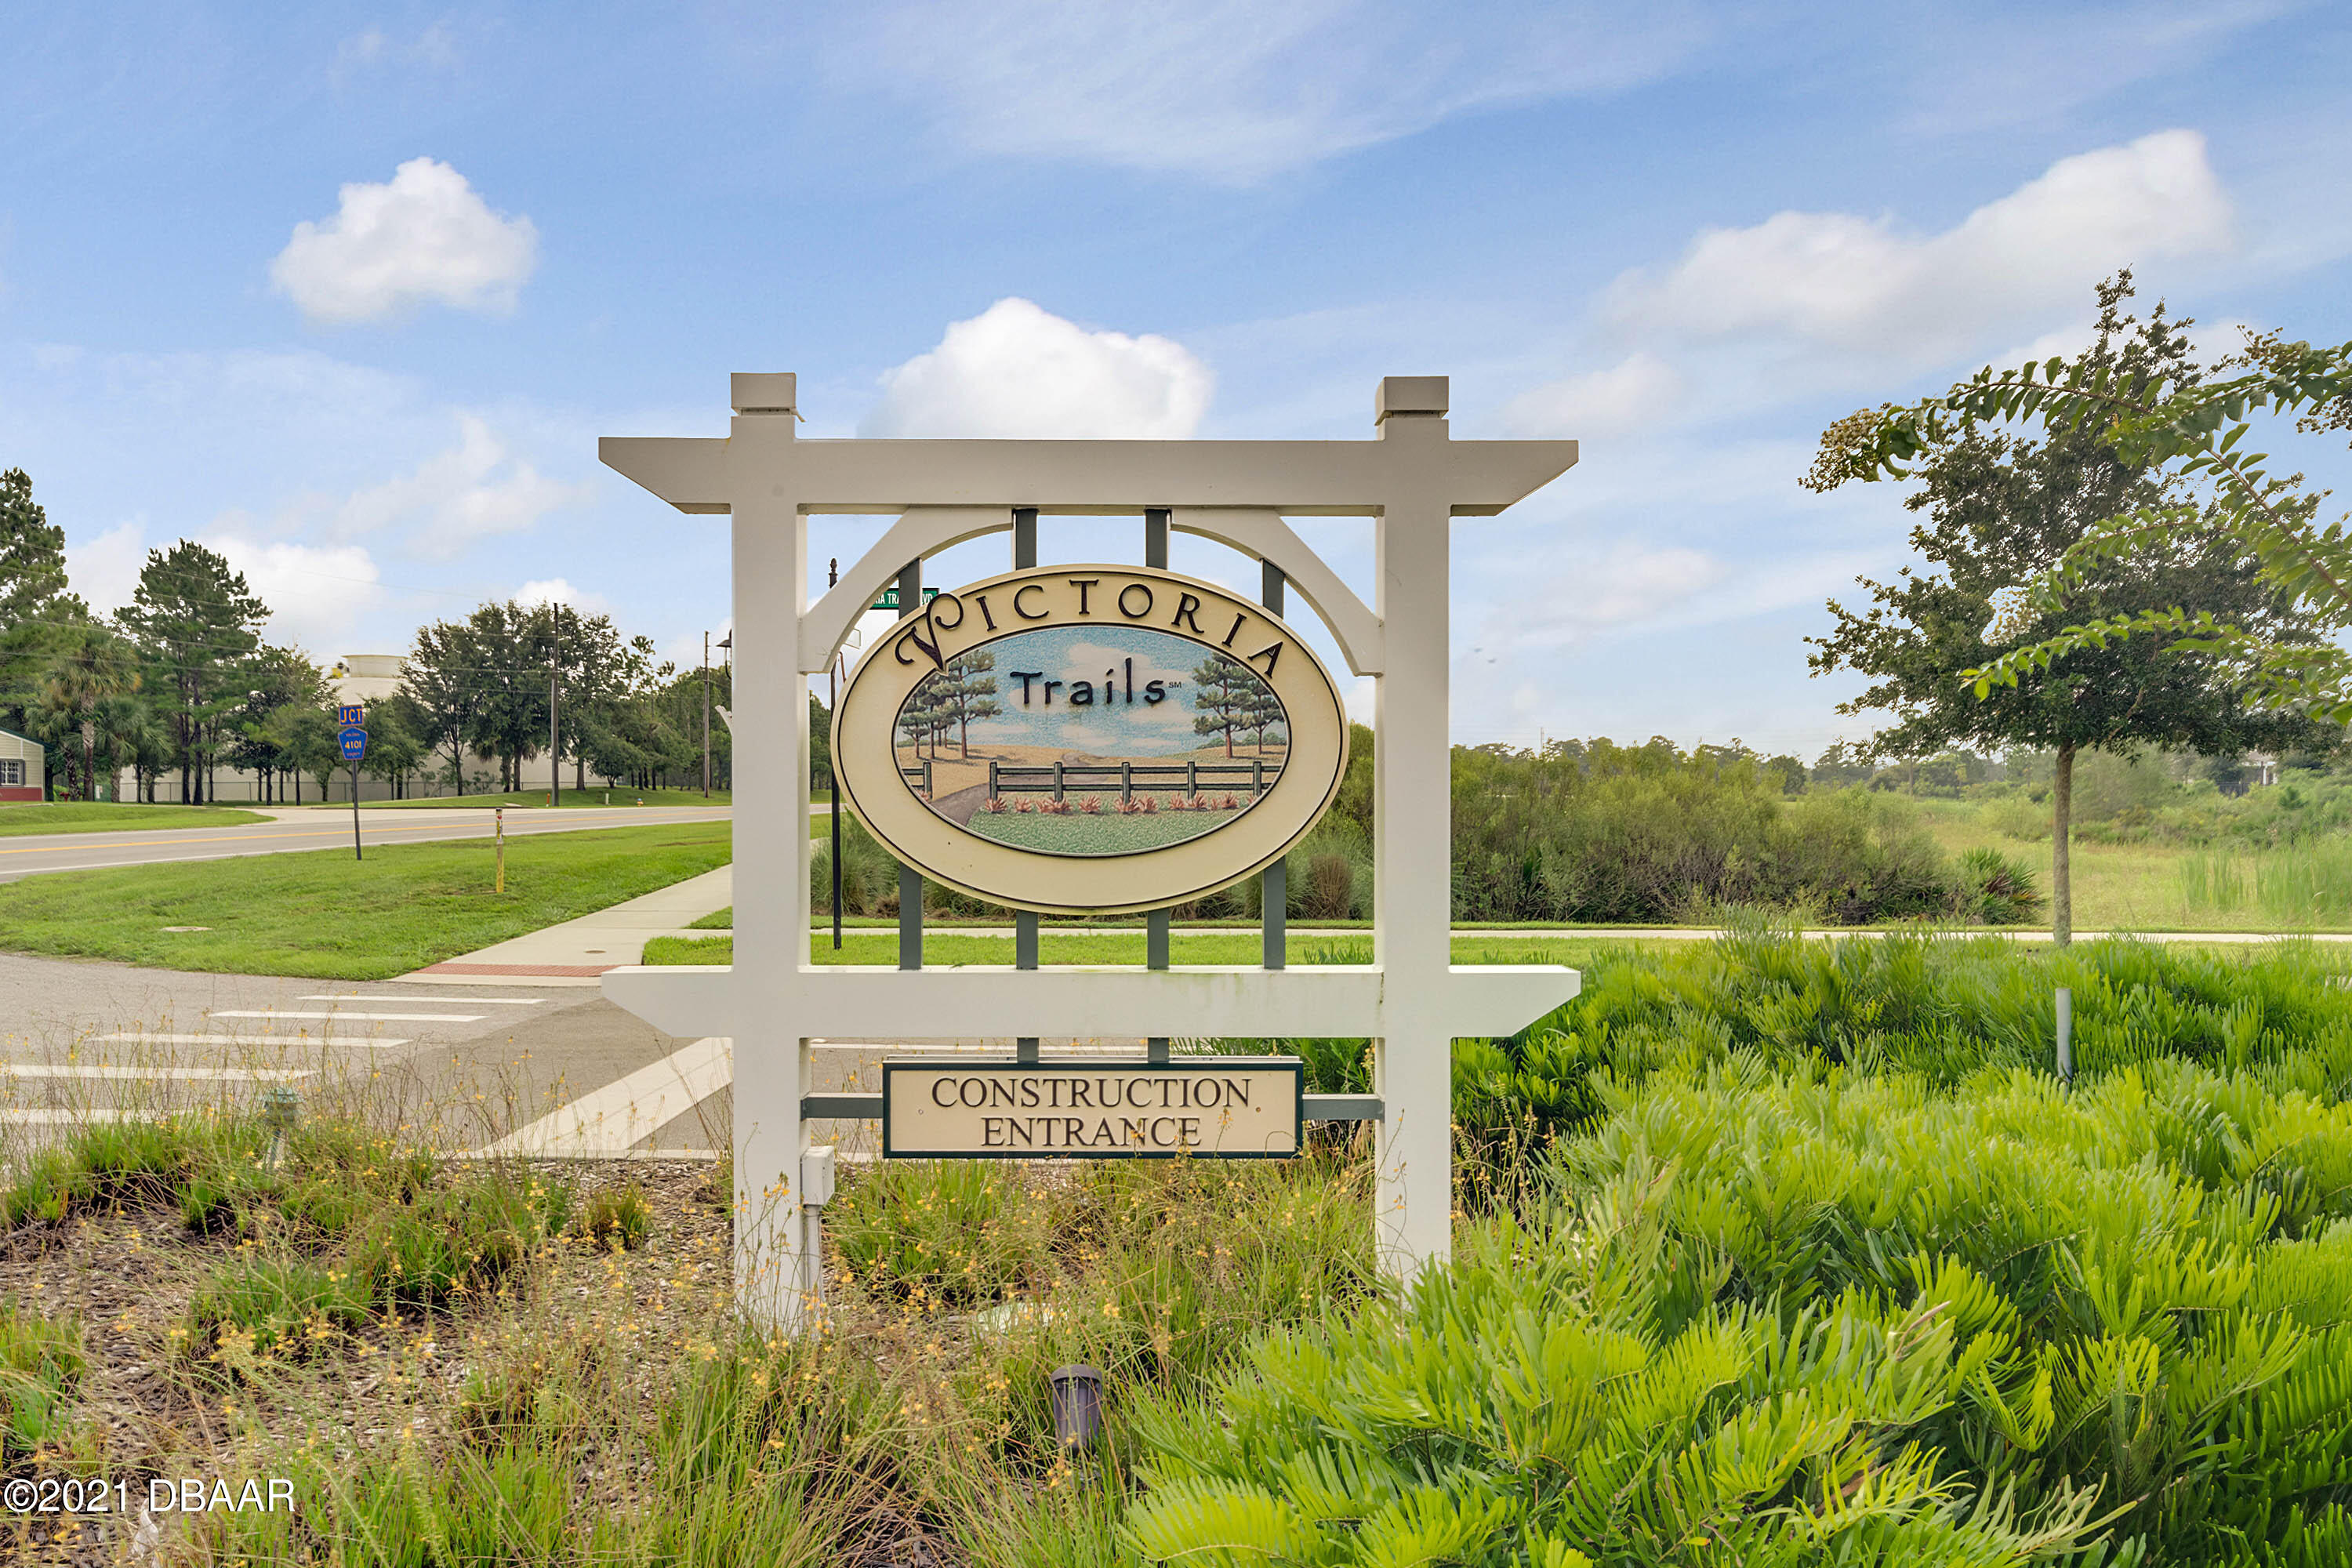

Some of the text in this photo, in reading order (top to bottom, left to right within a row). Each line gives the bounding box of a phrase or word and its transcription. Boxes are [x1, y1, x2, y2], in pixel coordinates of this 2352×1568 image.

[895, 579, 1283, 679] VICTORIA
[1009, 657, 1166, 705] Trails
[340, 709, 361, 723] JCT
[345, 740, 361, 749] 4101
[931, 1077, 1252, 1108] CONSTRUCTION
[980, 1116, 1202, 1147] ENTRANCE
